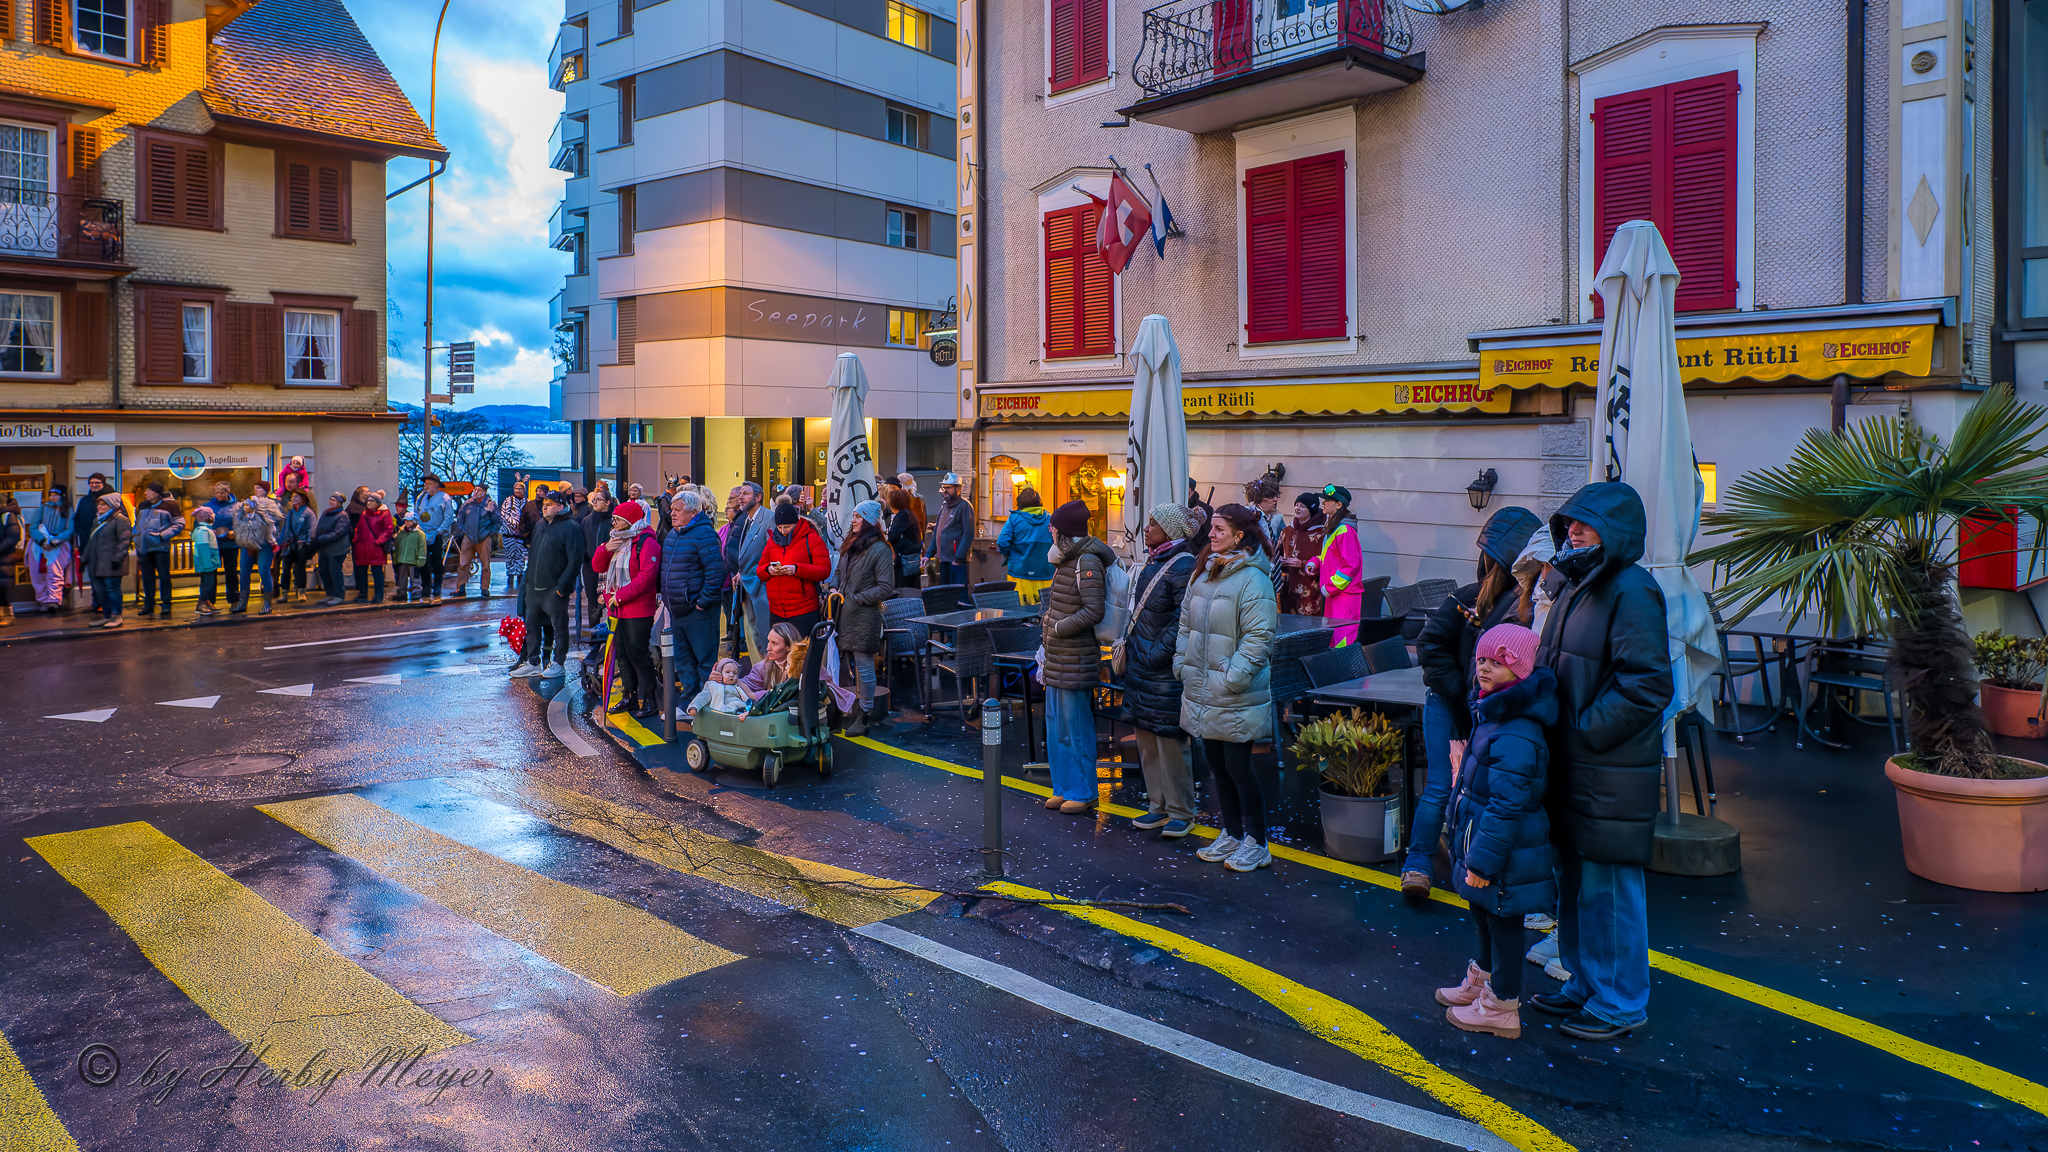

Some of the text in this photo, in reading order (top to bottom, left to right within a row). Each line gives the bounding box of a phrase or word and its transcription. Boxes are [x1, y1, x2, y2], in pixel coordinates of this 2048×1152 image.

[747, 299, 866, 331] Seepark
[1840, 341, 1911, 358] EICHHOF
[1505, 359, 1554, 372] EICHHOF
[1570, 356, 1600, 372] Re
[1723, 345, 1799, 366] Rütli
[997, 396, 1040, 410] EICHHOF
[1183, 392, 1255, 407] rant Rütli
[145, 456, 165, 465] Villa
[174, 456, 199, 470] VK
